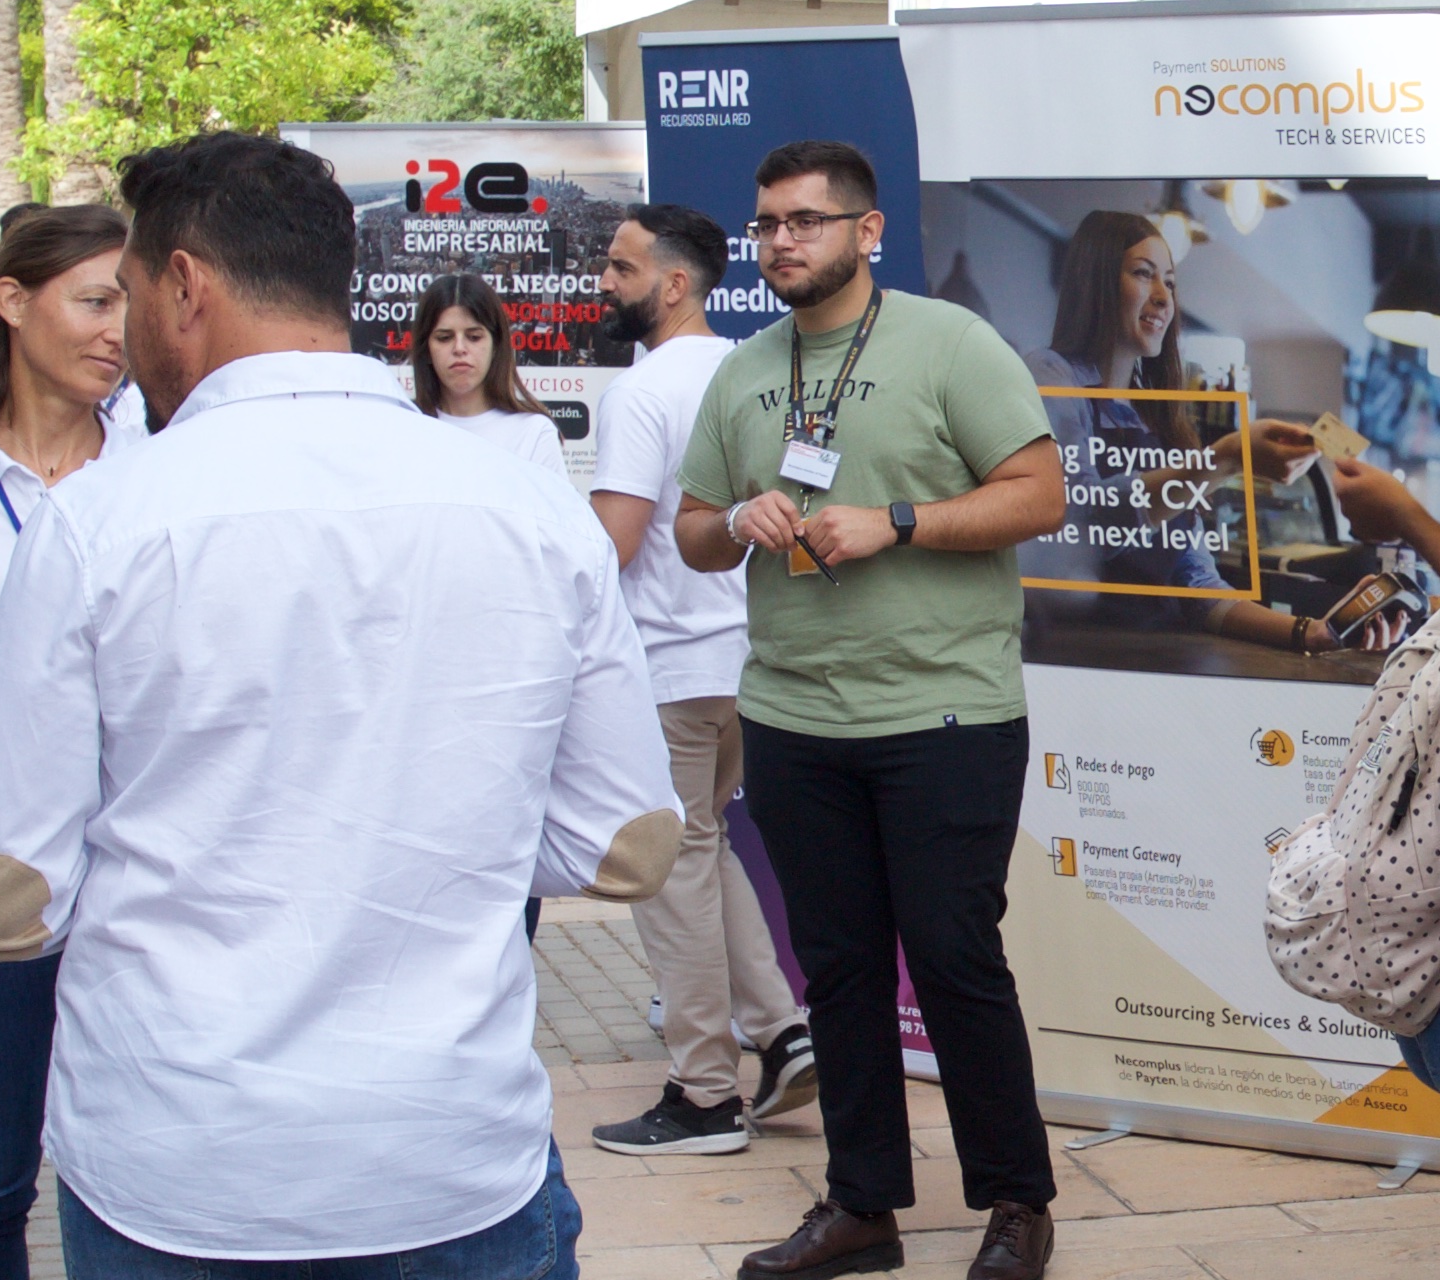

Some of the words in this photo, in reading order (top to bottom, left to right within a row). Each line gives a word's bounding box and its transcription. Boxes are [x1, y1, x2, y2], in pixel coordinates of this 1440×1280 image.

[1153, 60, 1207, 78] Payment
[1210, 58, 1286, 73] SOLUTIONS
[1154, 68, 1425, 126] necomplus
[661, 114, 704, 127] RECURSOS
[706, 113, 718, 127] EN
[720, 113, 731, 126] LA
[732, 113, 750, 126] RED
[1276, 129, 1319, 145] TECH
[1325, 129, 1336, 145] &
[1342, 128, 1426, 145] SERVICES
[404, 233, 550, 253] EMPRESARIAL
[513, 274, 602, 294] NEGOCI
[1088, 436, 1217, 477] Payment
[1129, 478, 1152, 509] &
[1162, 480, 1212, 511] CX
[1089, 523, 1153, 549] next
[1161, 520, 1229, 552] level
[1302, 730, 1351, 747] E-comm
[1076, 756, 1107, 773] Redes
[1111, 760, 1124, 775] de
[1128, 763, 1155, 781] pago
[1083, 841, 1129, 860] Payment
[1132, 846, 1181, 867] Gateway
[1115, 996, 1215, 1027] Outsourcing
[1222, 1008, 1291, 1031] Services
[1298, 1015, 1313, 1032] &
[1318, 1017, 1398, 1041] Solutions
[1115, 1054, 1181, 1071] Necomplus
[1184, 1062, 1215, 1076] lidera
[1217, 1065, 1227, 1077] la
[1230, 1067, 1264, 1082] región
[1268, 1070, 1282, 1082] de
[1285, 1072, 1316, 1086] Iberia
[1329, 1077, 1408, 1097] Latinoamérica
[1119, 1070, 1132, 1082] de
[1136, 1071, 1179, 1088] Payten,
[1180, 1076, 1190, 1088] la
[1192, 1077, 1233, 1092] división
[1236, 1082, 1251, 1094] de
[1253, 1085, 1293, 1100] medios
[1297, 1088, 1311, 1101] de
[1315, 1093, 1342, 1107] pago
[1345, 1095, 1360, 1106] de
[1363, 1097, 1407, 1112] Asseco
